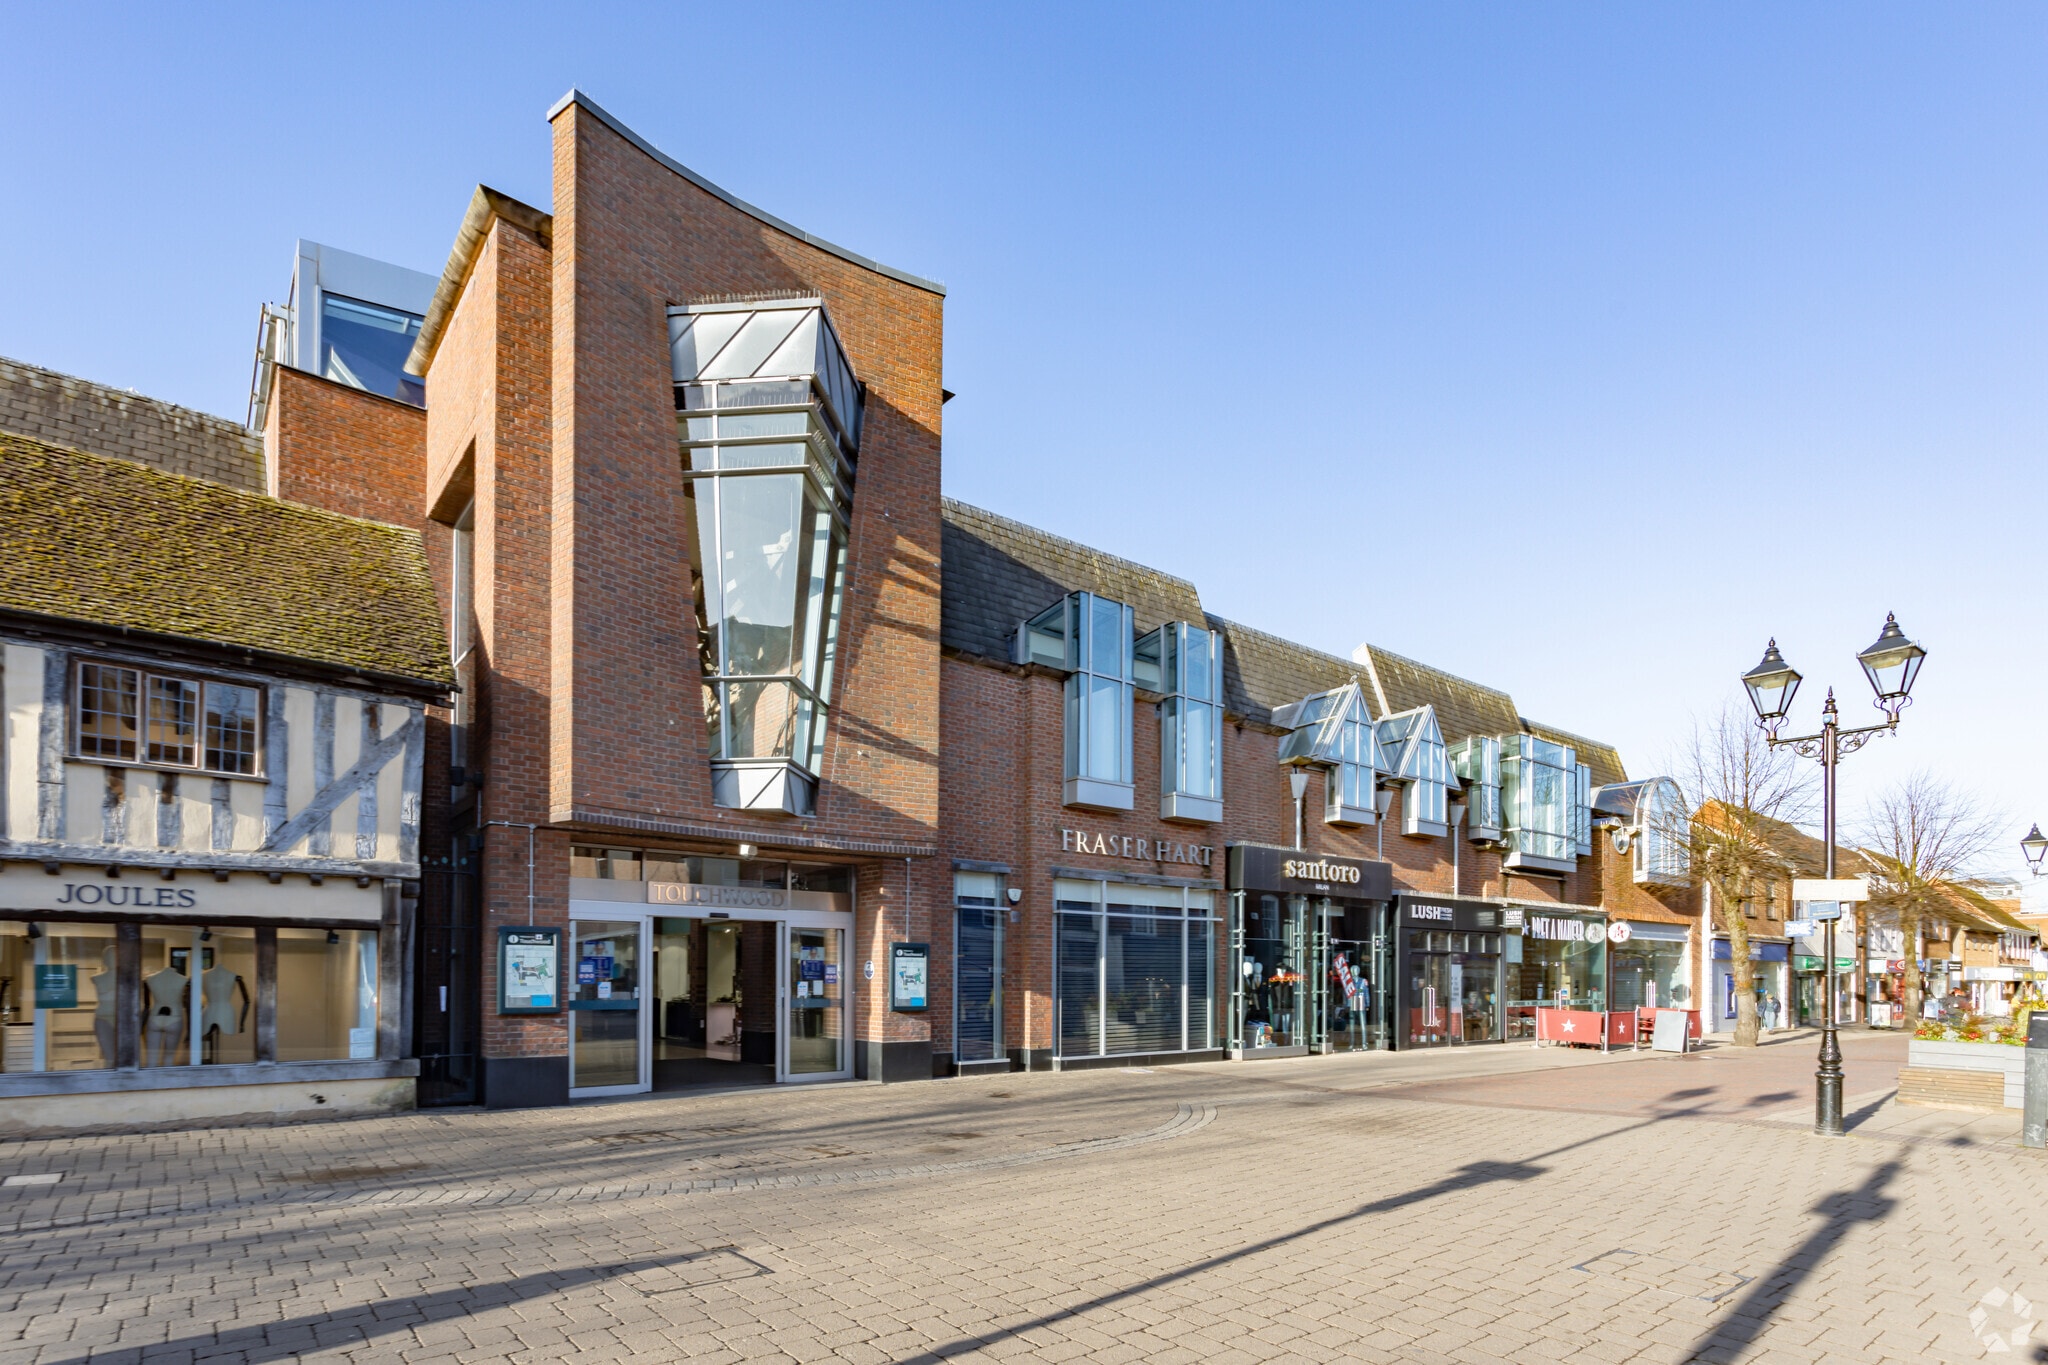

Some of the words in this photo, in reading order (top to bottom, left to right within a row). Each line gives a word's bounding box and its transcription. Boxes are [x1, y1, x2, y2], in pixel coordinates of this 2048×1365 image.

[1060, 828, 1150, 861] FRASER
[1154, 839, 1214, 867] HART
[1285, 859, 1361, 884] santoro
[56, 883, 196, 908] JOULES
[653, 883, 784, 908] TOUCHWOOD
[1411, 904, 1441, 920] LUSH
[1550, 918, 1557, 940] A
[1334, 956, 1356, 996] SALE
